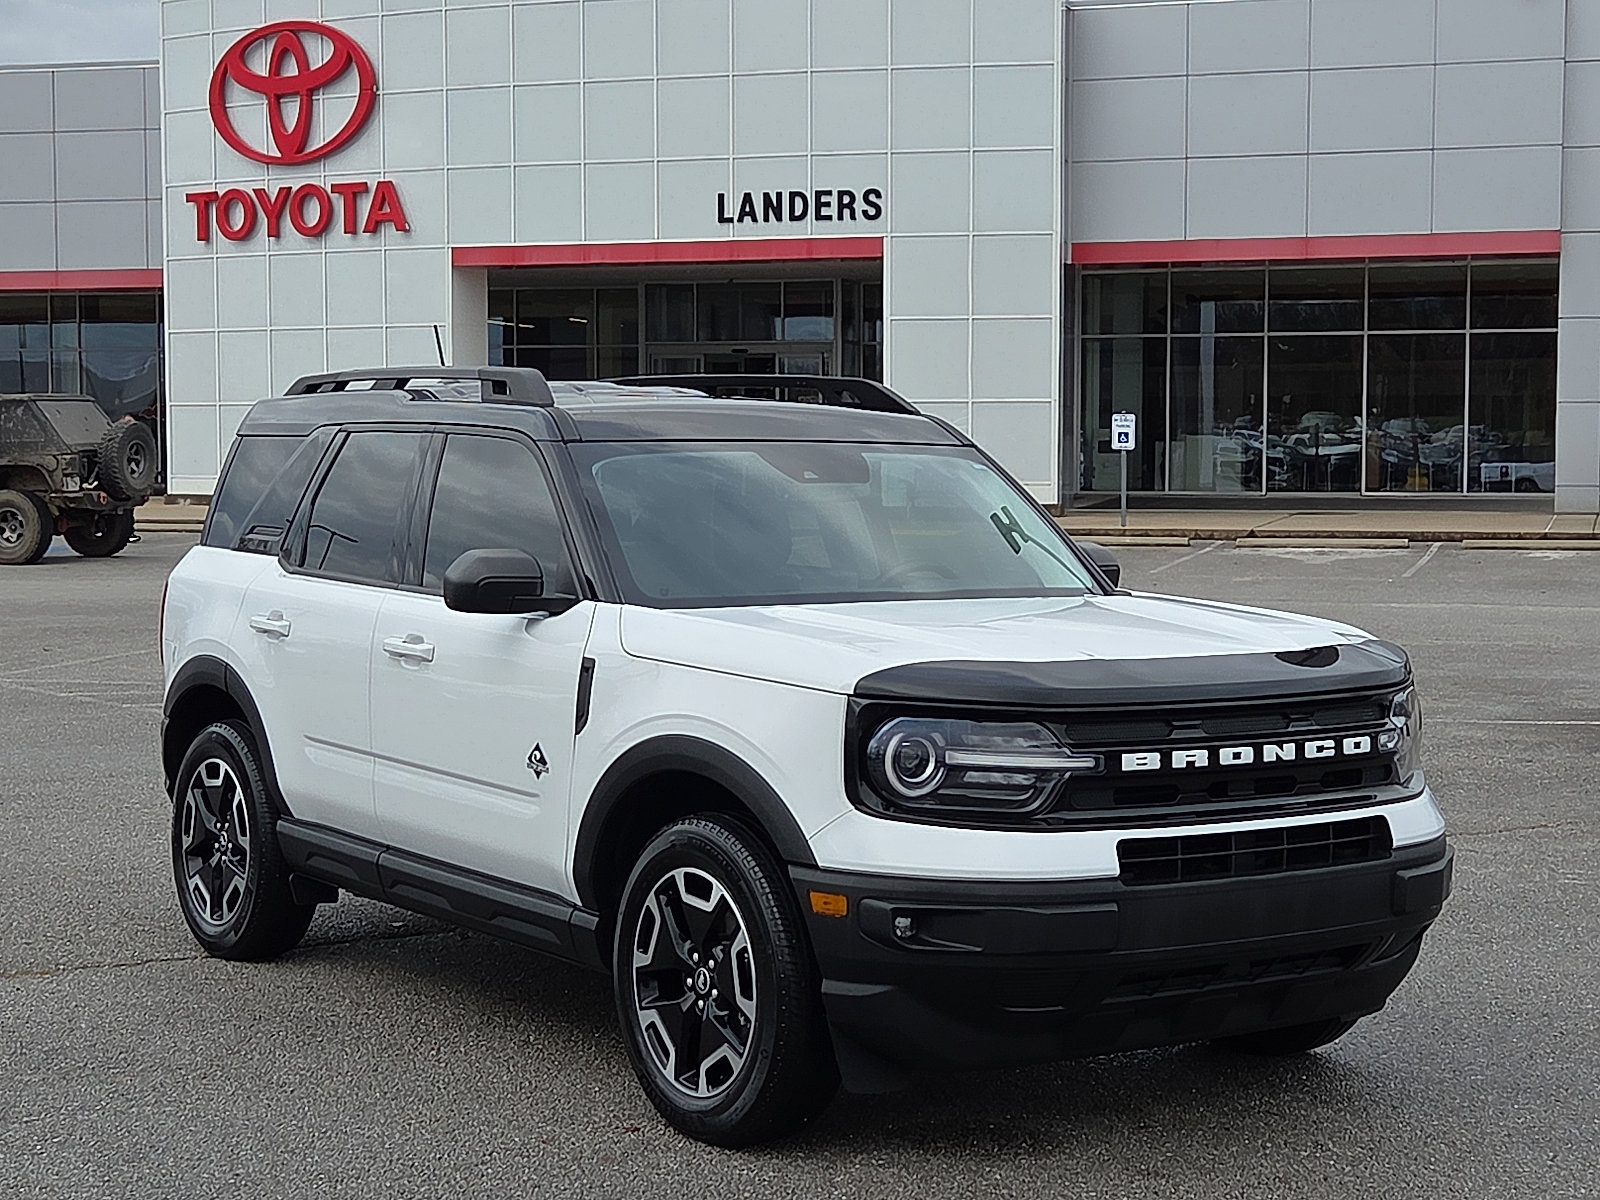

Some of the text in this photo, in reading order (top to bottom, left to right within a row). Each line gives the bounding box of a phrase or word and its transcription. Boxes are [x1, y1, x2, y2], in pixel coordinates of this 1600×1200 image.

[186, 181, 409, 241] TOYOTA
[718, 189, 883, 224] LANDERS
[1121, 736, 1371, 771] BRONCO
